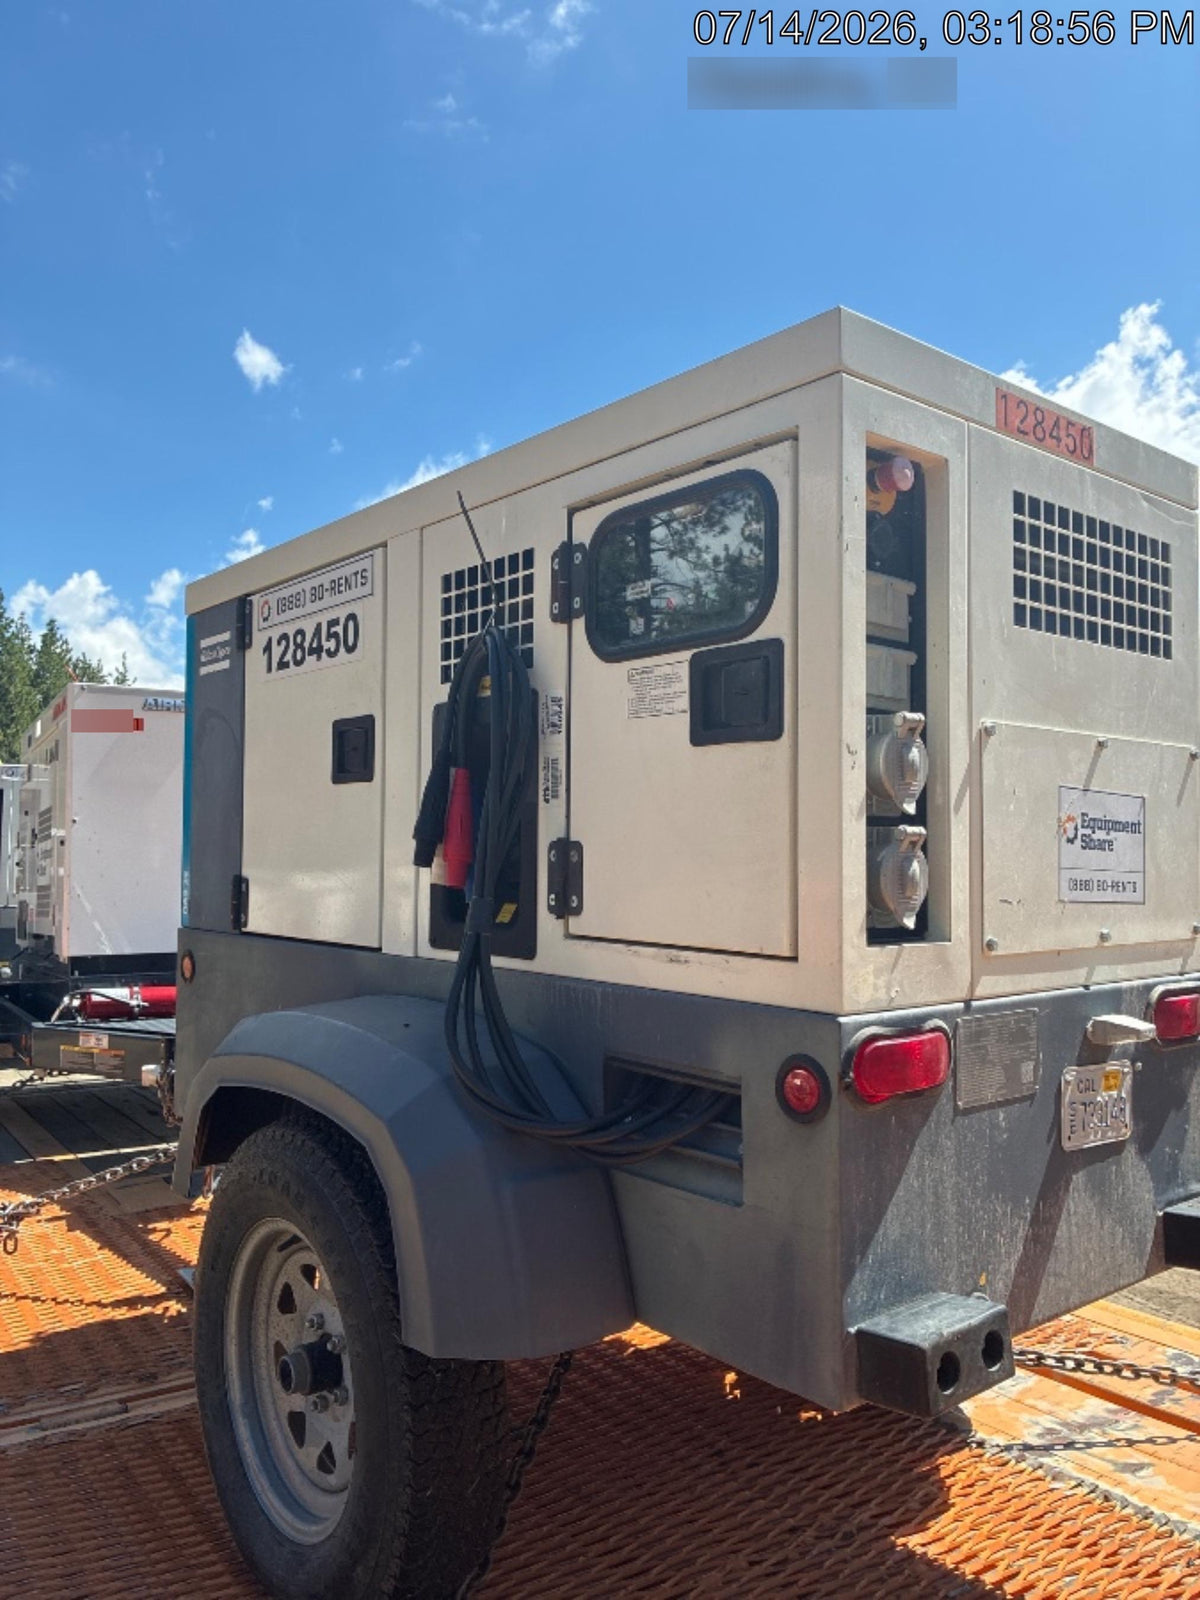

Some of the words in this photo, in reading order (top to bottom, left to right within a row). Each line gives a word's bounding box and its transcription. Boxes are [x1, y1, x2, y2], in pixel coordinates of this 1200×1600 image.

[1001, 394, 1093, 460] 128450
[276, 588, 307, 616] (888)
[310, 568, 369, 603] 80-RENTS
[262, 612, 360, 674] 128450
[1080, 811, 1142, 836] Equipment
[1080, 833, 1115, 852] Share
[1077, 1078, 1096, 1094] CAL
